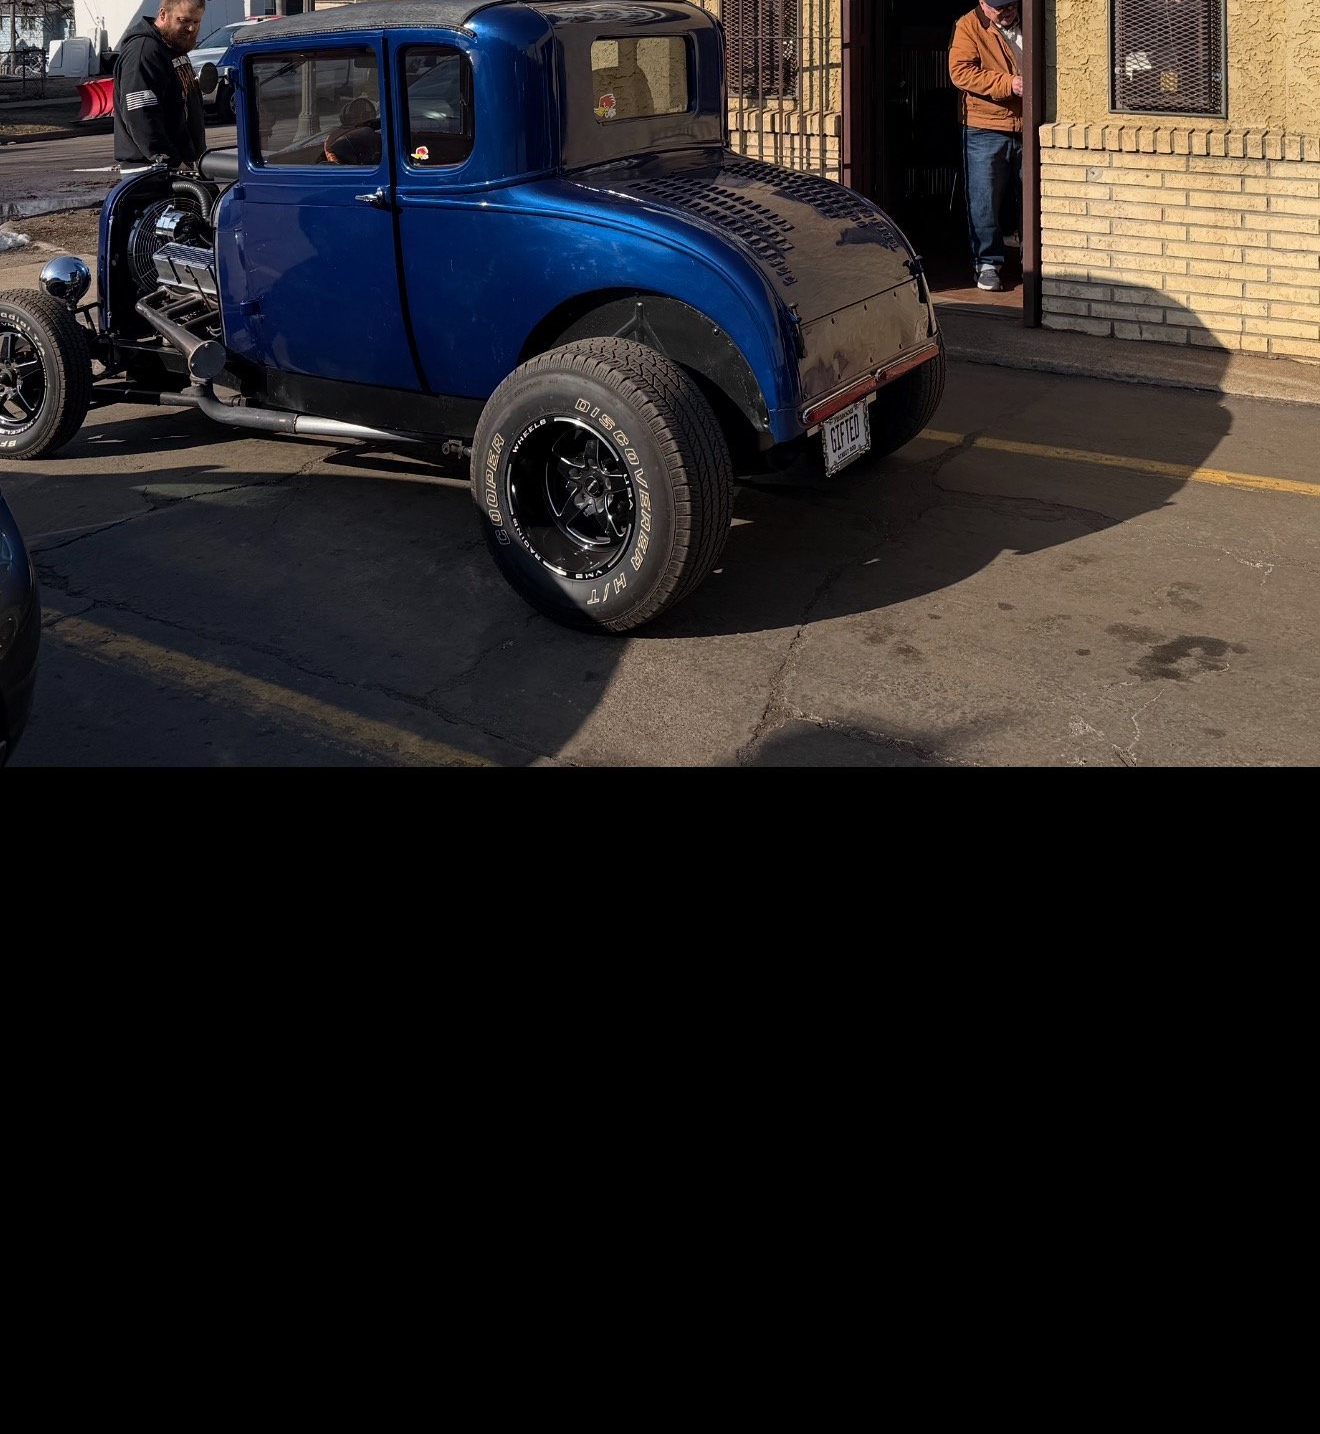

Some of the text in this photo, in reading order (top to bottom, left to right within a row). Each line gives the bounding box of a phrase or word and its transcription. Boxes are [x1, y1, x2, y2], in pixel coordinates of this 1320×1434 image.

[512, 418, 547, 453] WHEELS
[831, 414, 860, 454] GIFTED
[485, 433, 511, 546] COOPER
[574, 398, 652, 605] DISCOVERER H/T
